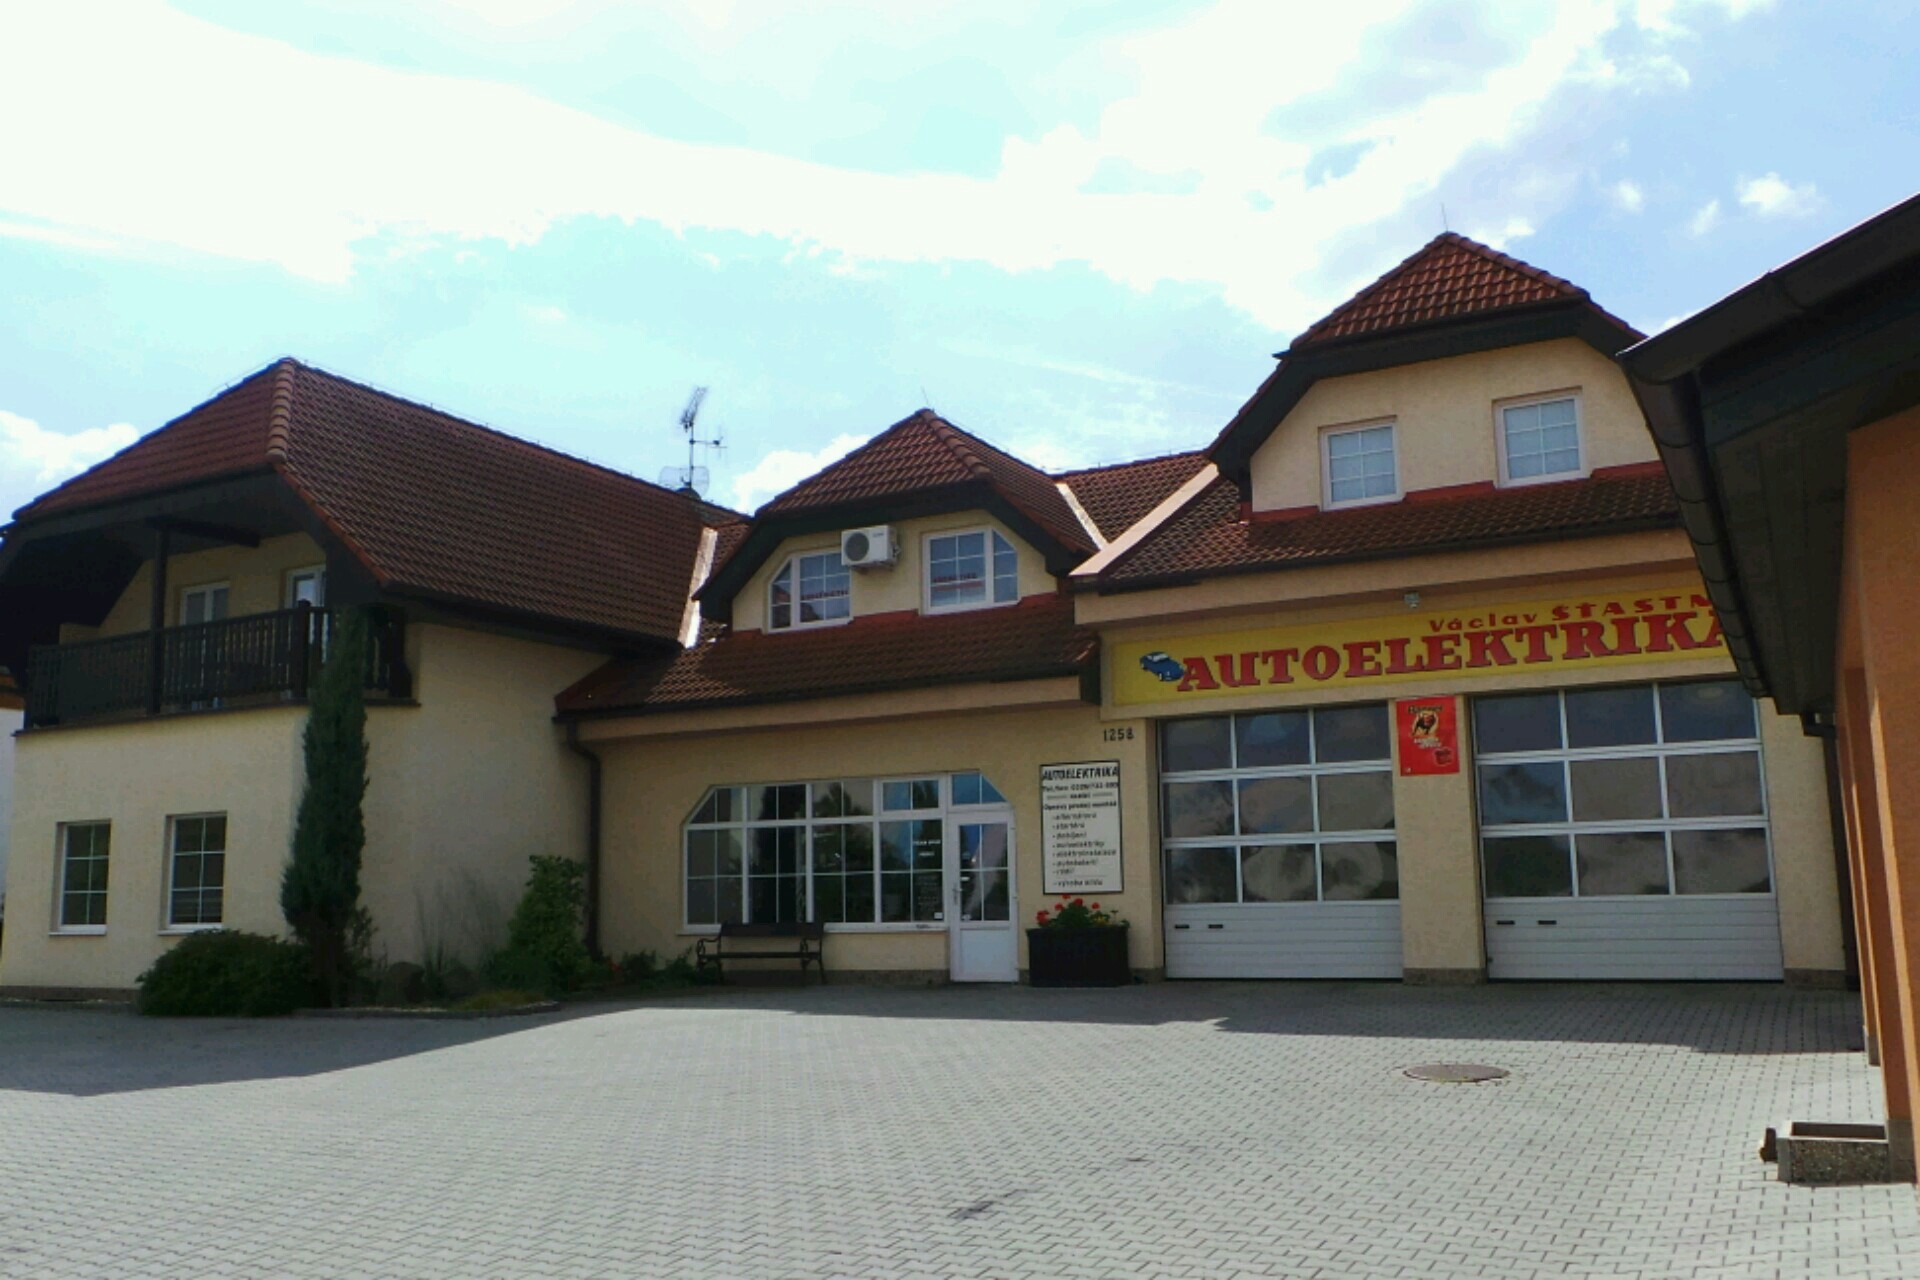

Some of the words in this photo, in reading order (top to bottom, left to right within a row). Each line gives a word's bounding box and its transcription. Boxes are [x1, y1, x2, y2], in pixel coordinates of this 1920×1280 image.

[1429, 612, 1537, 632] Václav
[1103, 727, 1135, 742] 1258
[1043, 767, 1118, 781] AUTOELEKTRIKA
